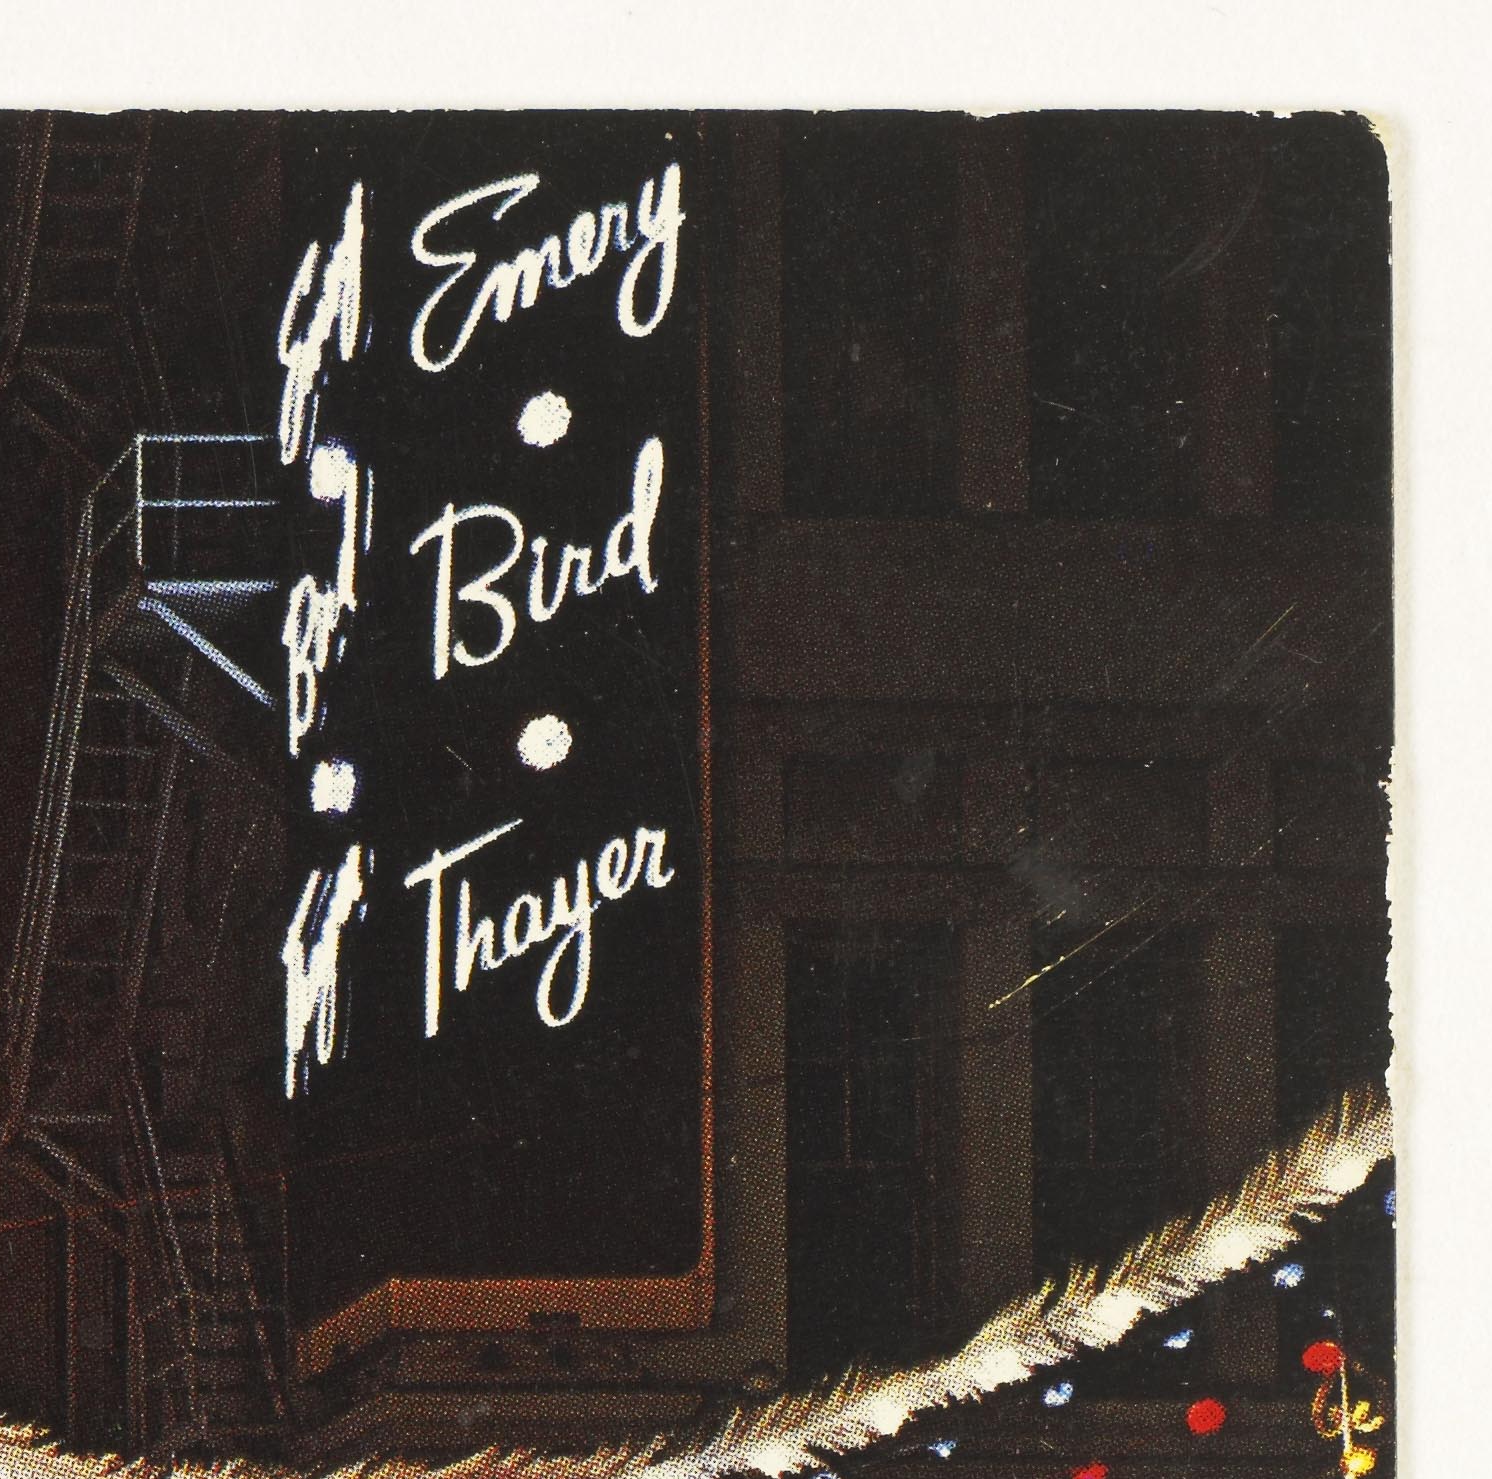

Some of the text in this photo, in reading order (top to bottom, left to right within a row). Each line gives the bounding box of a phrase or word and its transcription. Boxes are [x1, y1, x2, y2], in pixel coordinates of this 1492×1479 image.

[411, 164, 685, 372] Emery
[410, 436, 664, 680] Bird
[404, 820, 674, 1037] Thayer
